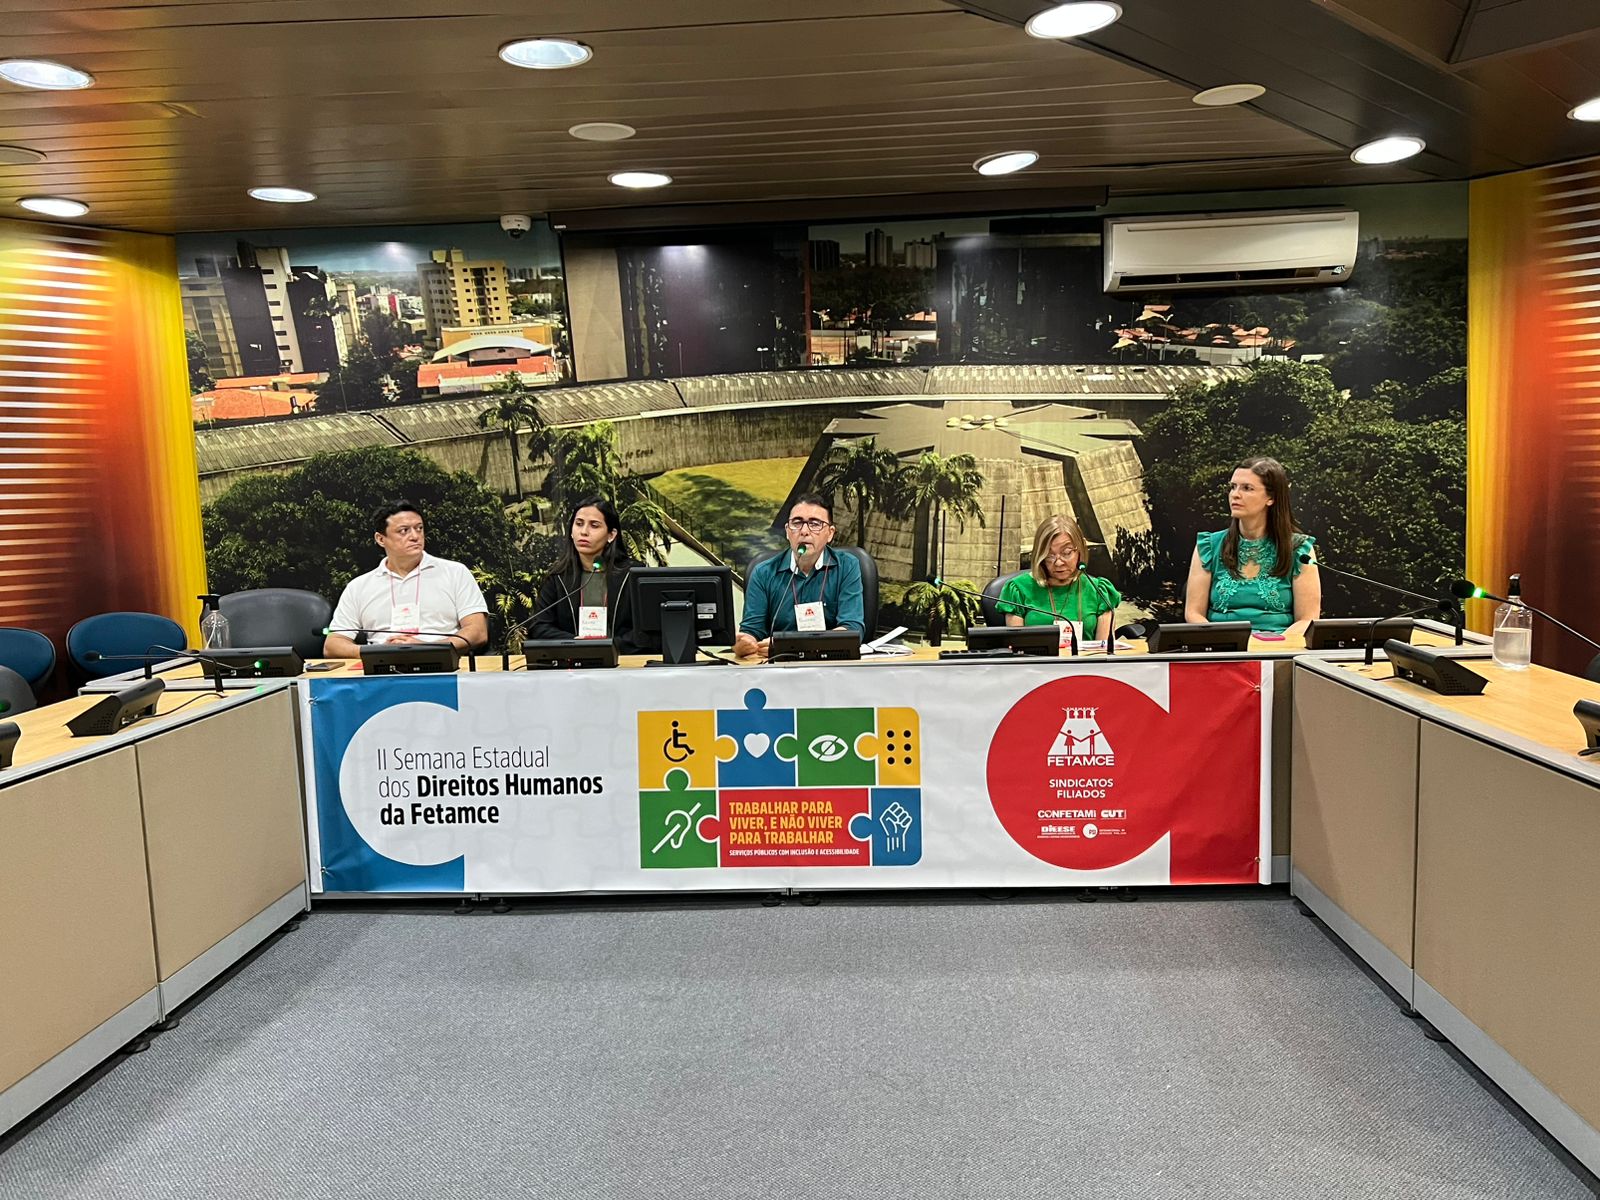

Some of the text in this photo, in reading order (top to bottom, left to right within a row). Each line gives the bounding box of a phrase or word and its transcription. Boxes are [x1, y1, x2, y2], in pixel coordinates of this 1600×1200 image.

[377, 746, 549, 770] II Semana Estadual
[1048, 756, 1114, 766] FETAMCE
[379, 774, 603, 798] dos Direitos Humanos
[1049, 779, 1113, 787] SINDICATOS
[1057, 790, 1105, 798] FILIADOS
[381, 803, 499, 825] da Fetamce
[729, 801, 832, 814] TRABALHAR PARA
[729, 815, 842, 830] VIVER, E NÃO VIVER
[729, 831, 833, 844] PARA TRABALHAR
